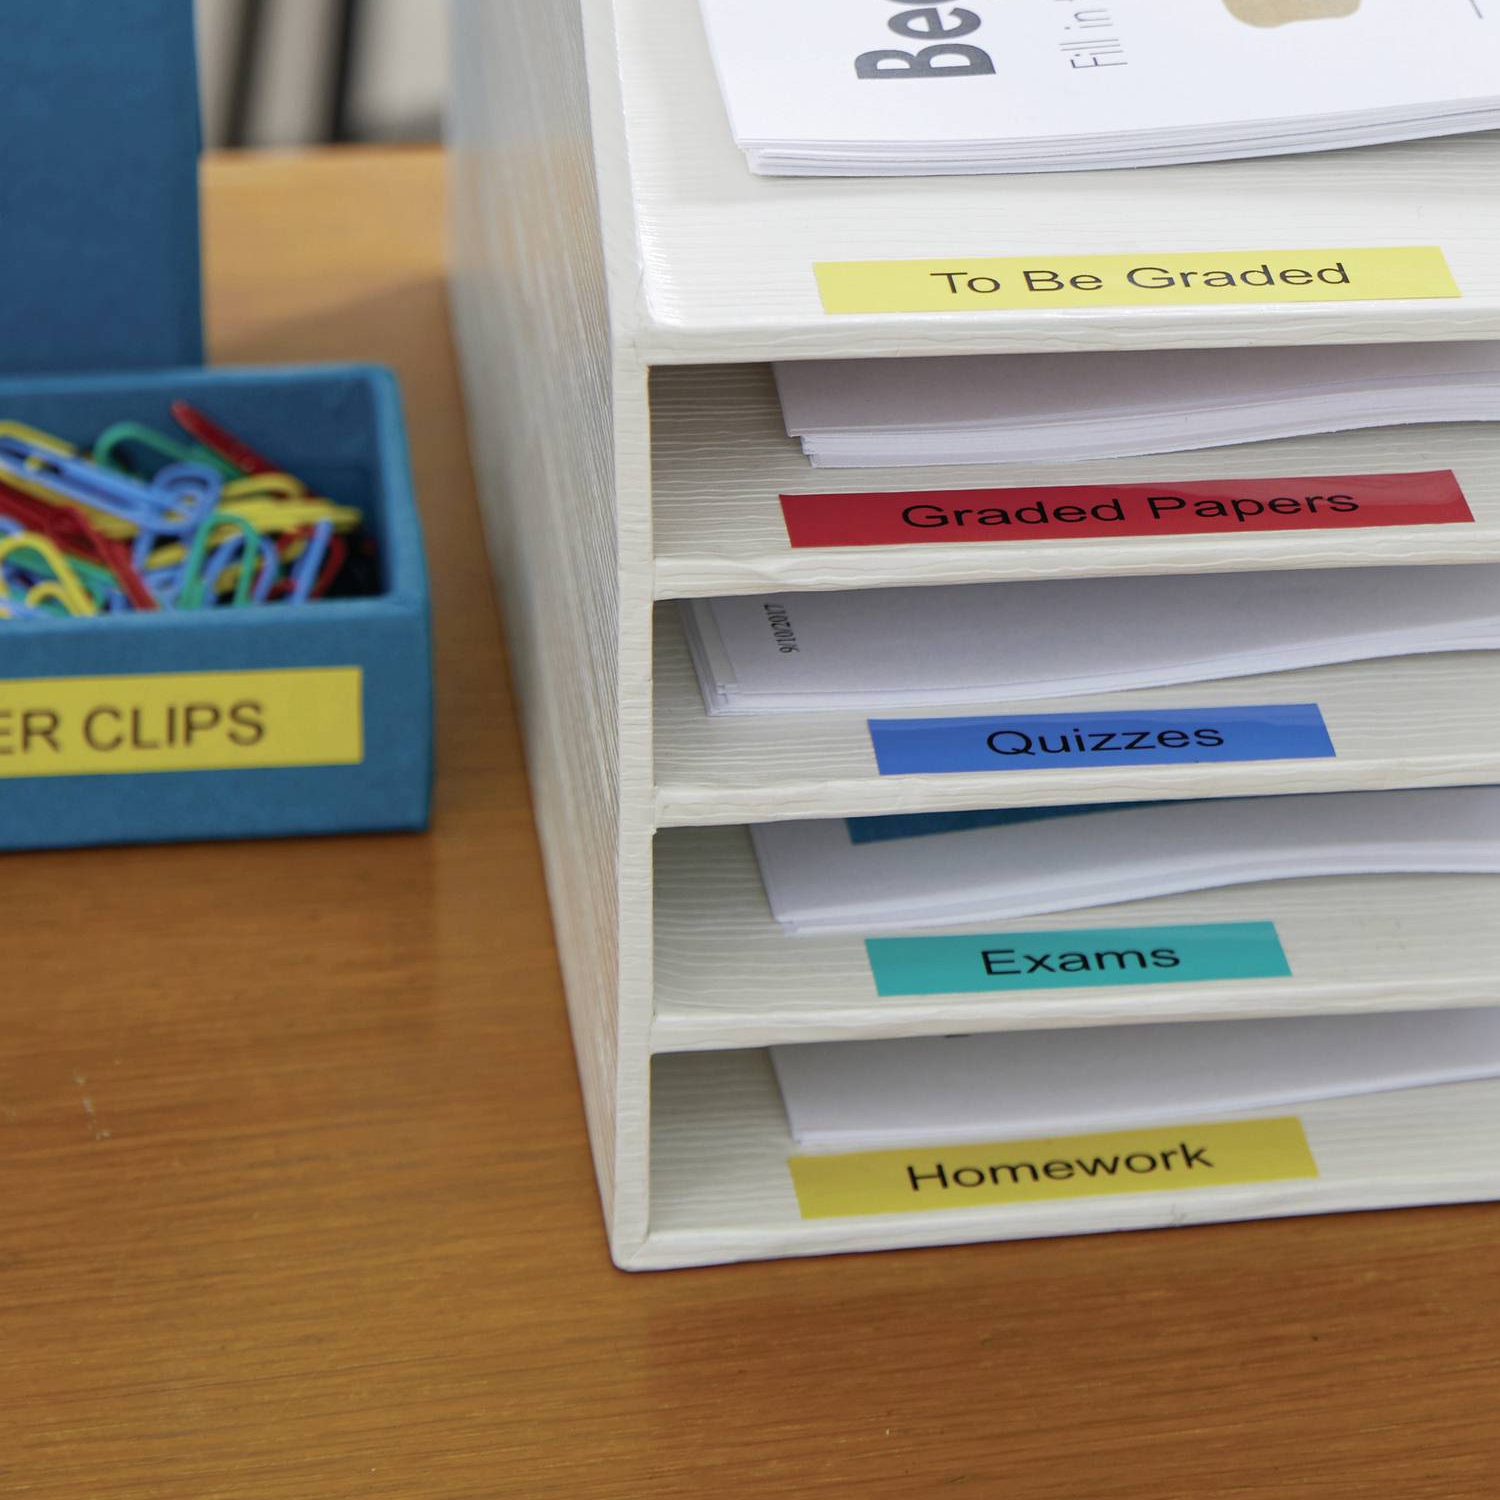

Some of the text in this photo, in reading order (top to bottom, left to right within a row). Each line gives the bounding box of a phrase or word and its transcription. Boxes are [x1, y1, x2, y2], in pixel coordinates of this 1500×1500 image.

[1064, 8, 1114, 30] in
[1058, 38, 1128, 70] Fill
[930, 262, 1350, 295] To Be Graded
[902, 494, 1360, 529] Graded Papers
[764, 603, 800, 654] 9/10/2017
[82, 700, 265, 753] CLIPS
[986, 727, 1226, 756] Quizzes
[981, 945, 1182, 976] Exams
[906, 1142, 1215, 1192] Homework
